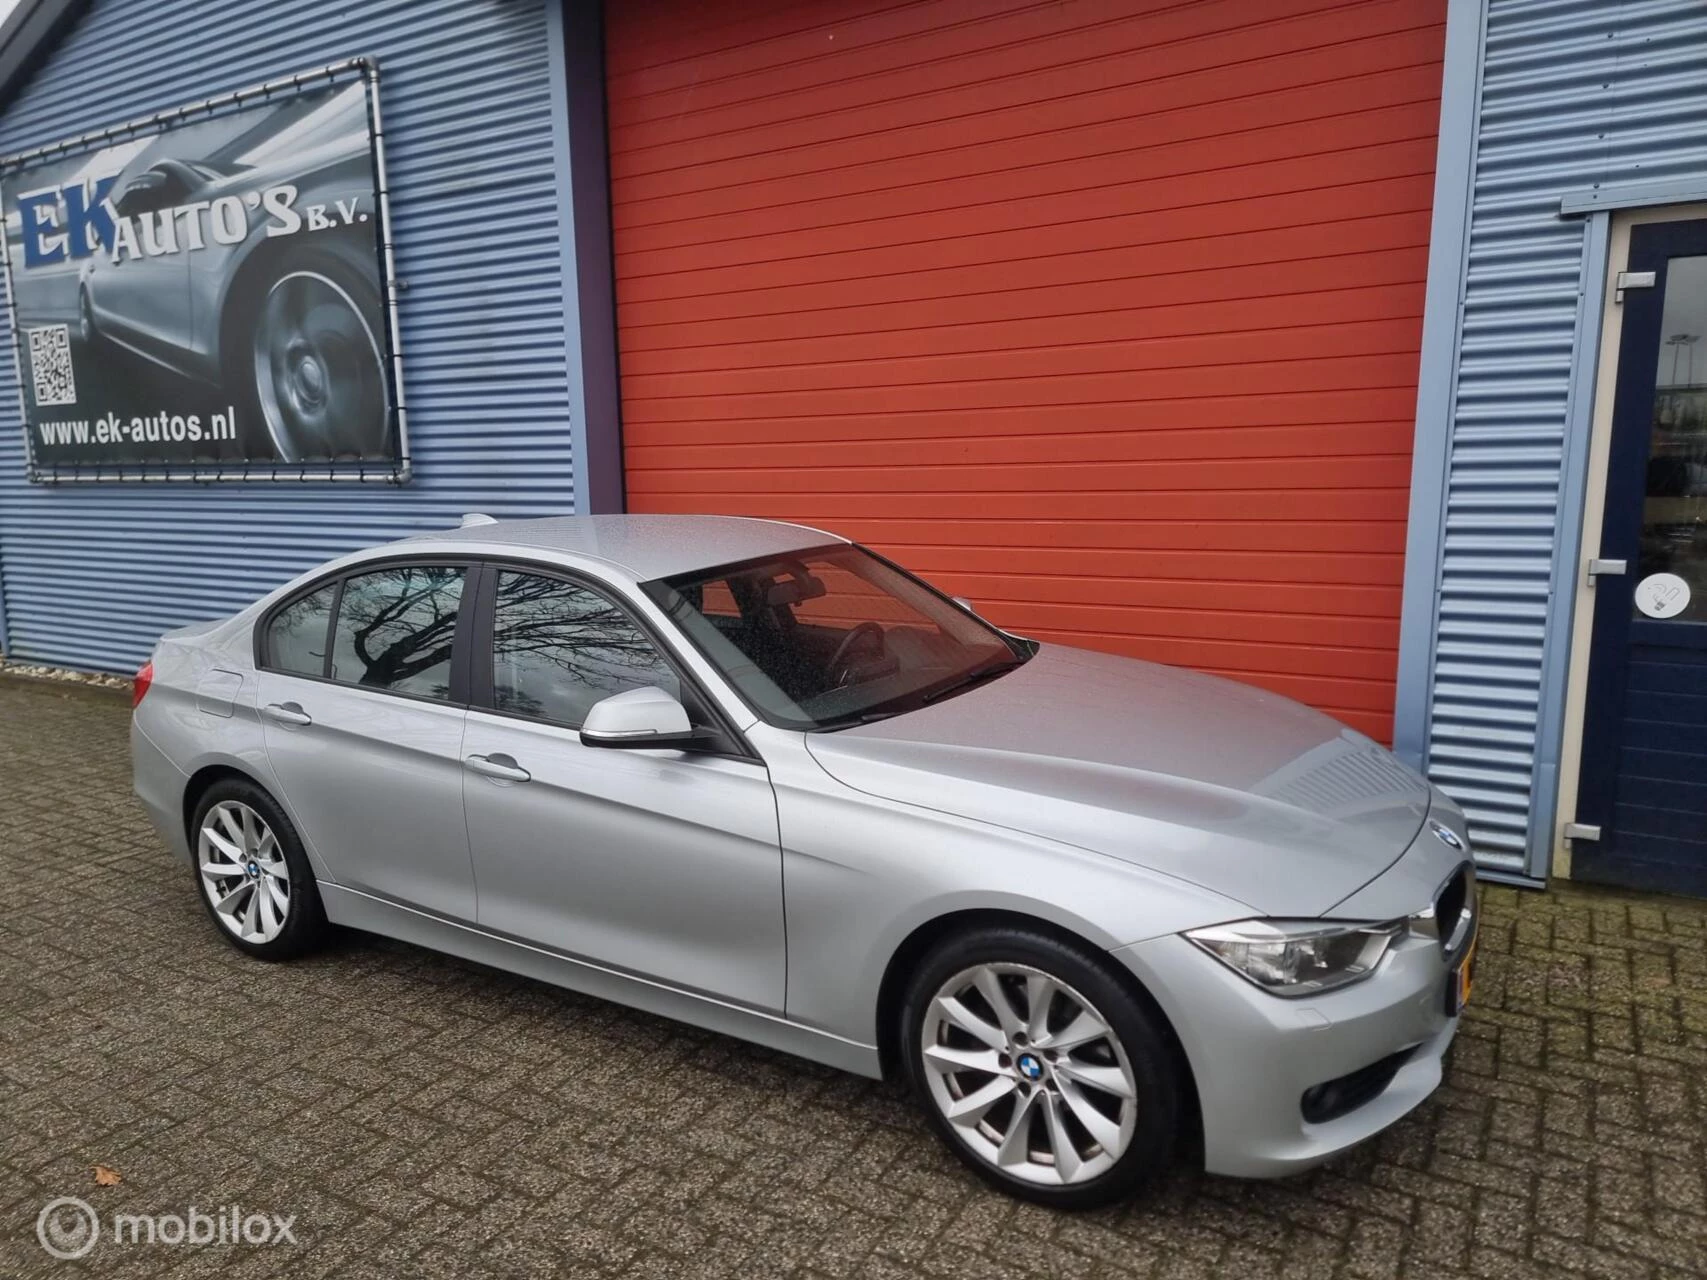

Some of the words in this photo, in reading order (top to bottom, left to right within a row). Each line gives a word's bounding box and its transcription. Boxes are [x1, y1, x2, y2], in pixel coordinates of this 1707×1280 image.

[17, 176, 118, 268] EK
[307, 197, 368, 232] B.V.
[40, 406, 236, 446] www.ek-autos.nl
